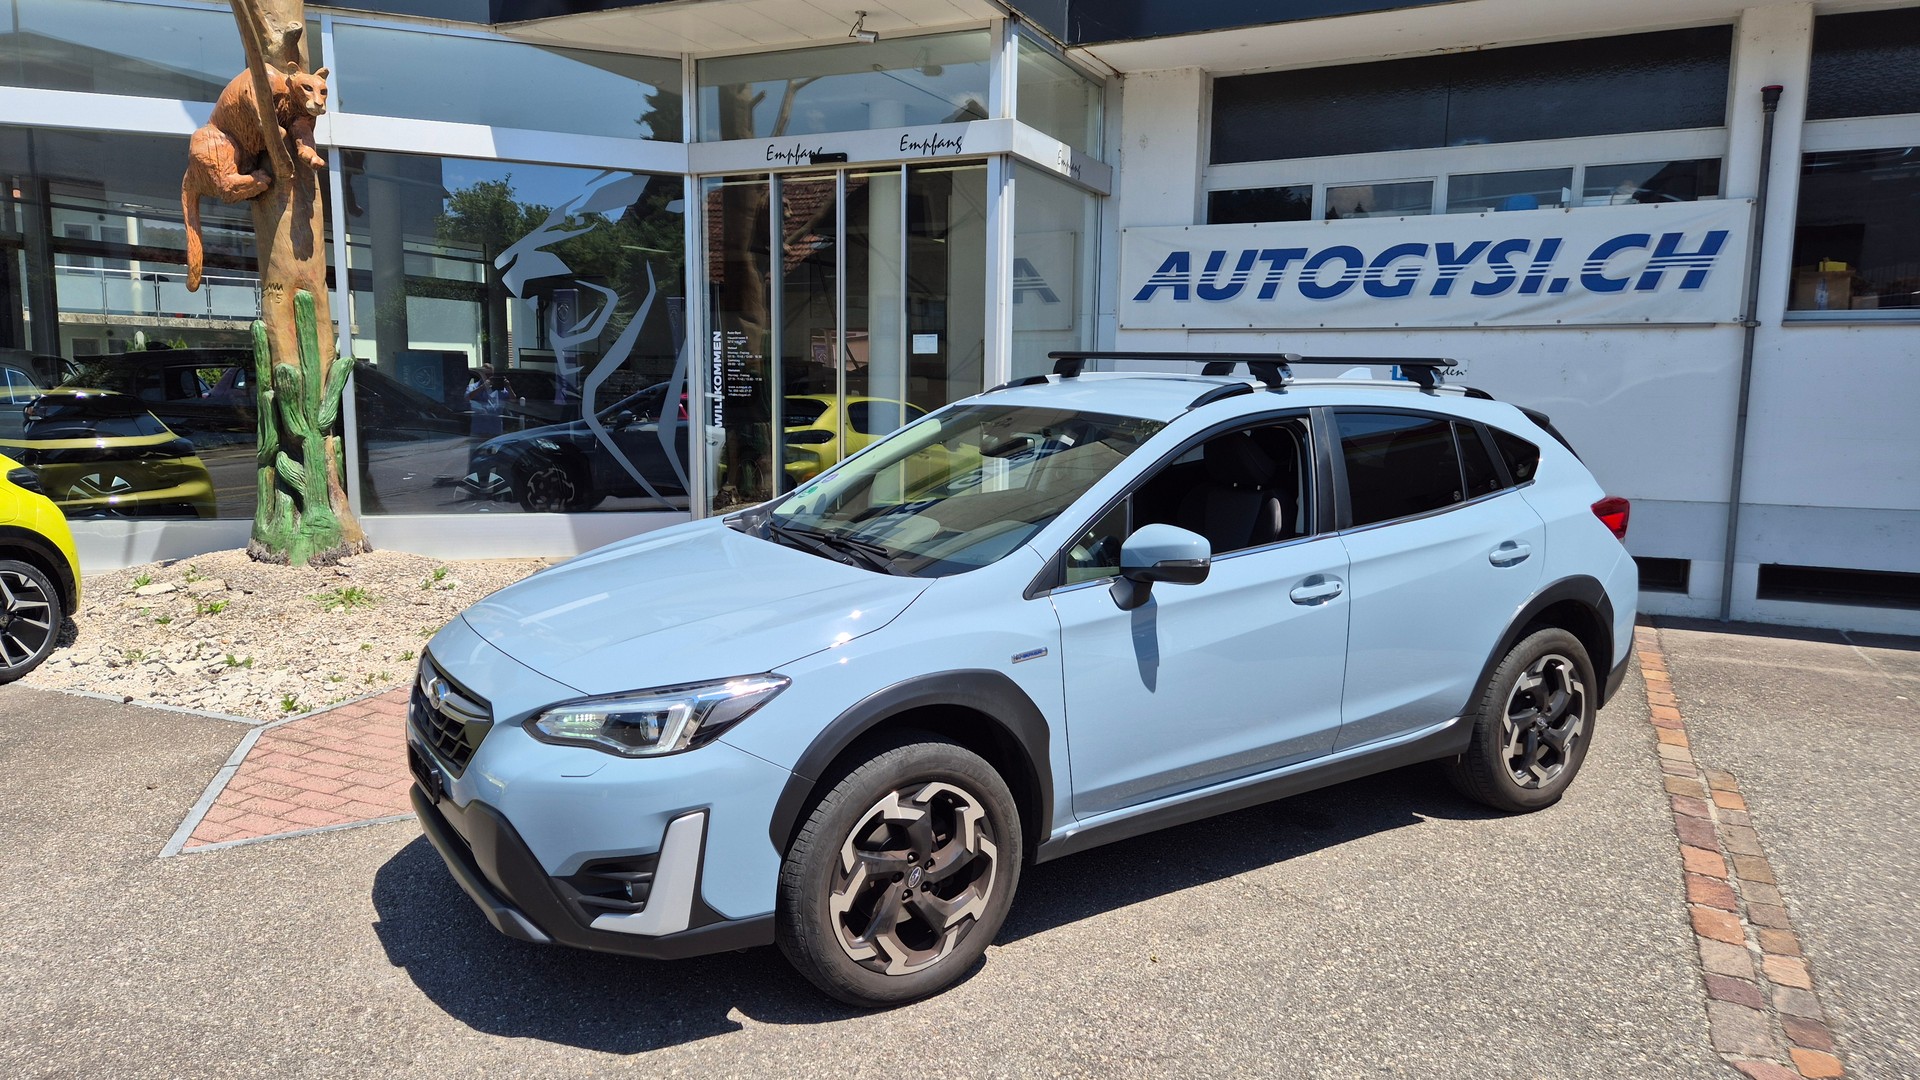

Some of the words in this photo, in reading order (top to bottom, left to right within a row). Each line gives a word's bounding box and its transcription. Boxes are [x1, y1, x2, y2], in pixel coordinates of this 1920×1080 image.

[899, 132, 963, 156] Empfang
[1132, 229, 1731, 302] AUTOGYSI.CH
[713, 331, 723, 427] WILLKOMMEN
